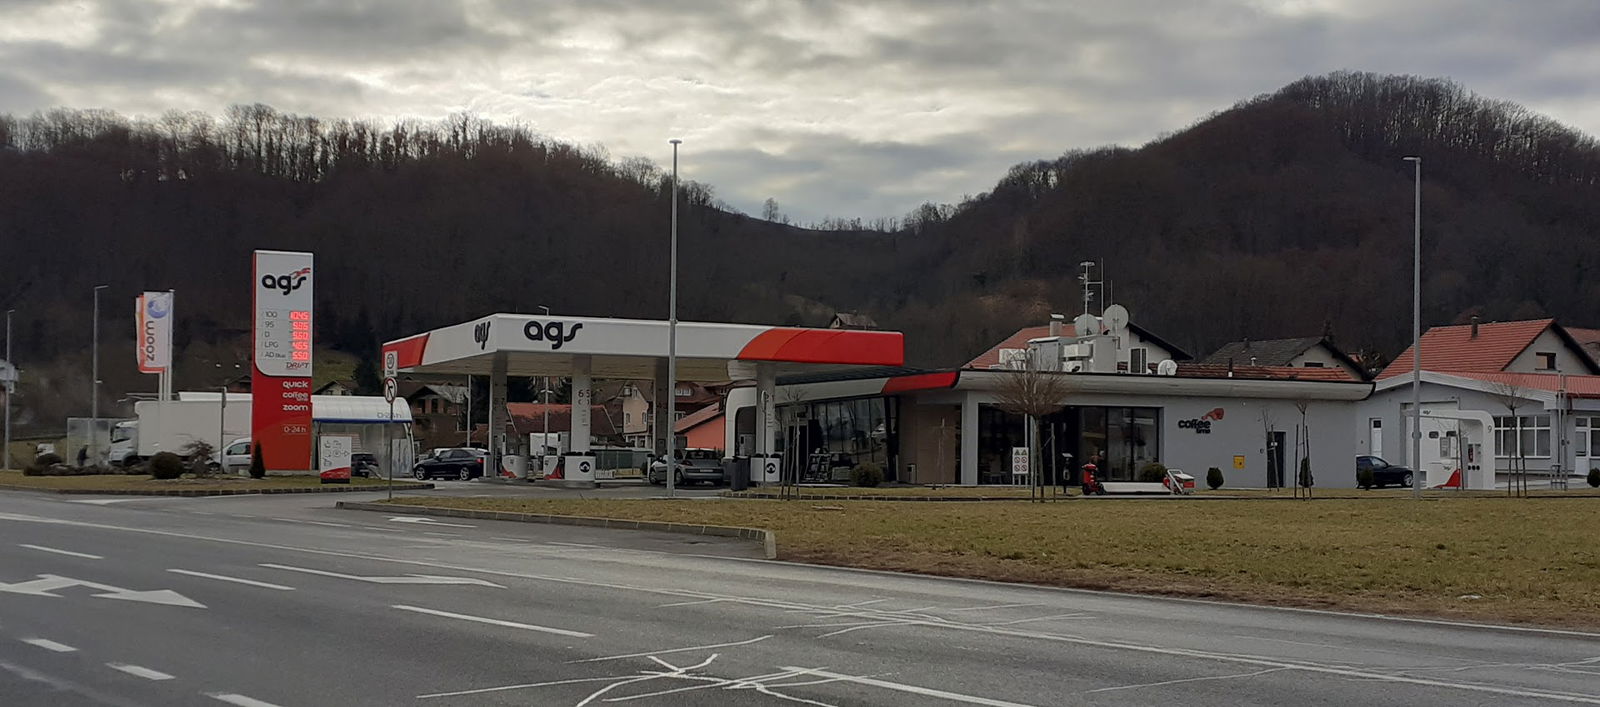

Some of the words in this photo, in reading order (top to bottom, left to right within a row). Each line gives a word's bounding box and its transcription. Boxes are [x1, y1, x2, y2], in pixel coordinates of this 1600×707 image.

[261, 274, 307, 296] ags
[145, 320, 155, 361] zoom
[524, 320, 583, 350] ags
[1178, 418, 1211, 428] coffee
[1487, 425, 1493, 433] 9
